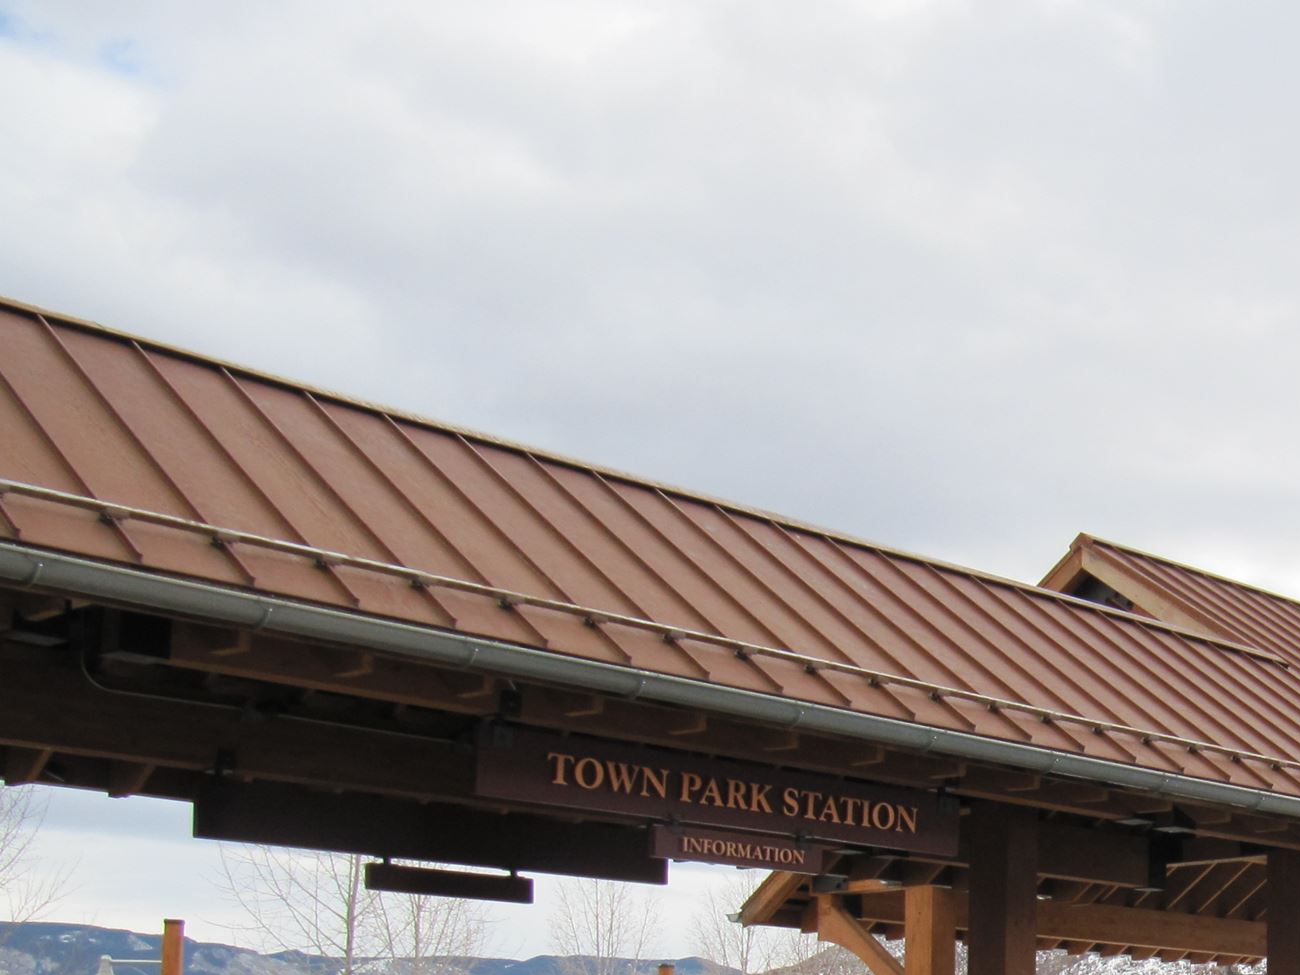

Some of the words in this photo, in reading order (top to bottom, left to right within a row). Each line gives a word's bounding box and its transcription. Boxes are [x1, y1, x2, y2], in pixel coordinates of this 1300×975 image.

[547, 753, 669, 799] TOWN
[679, 772, 773, 814] PARK
[783, 788, 918, 833] STATION
[682, 837, 805, 864] INFORMATION
